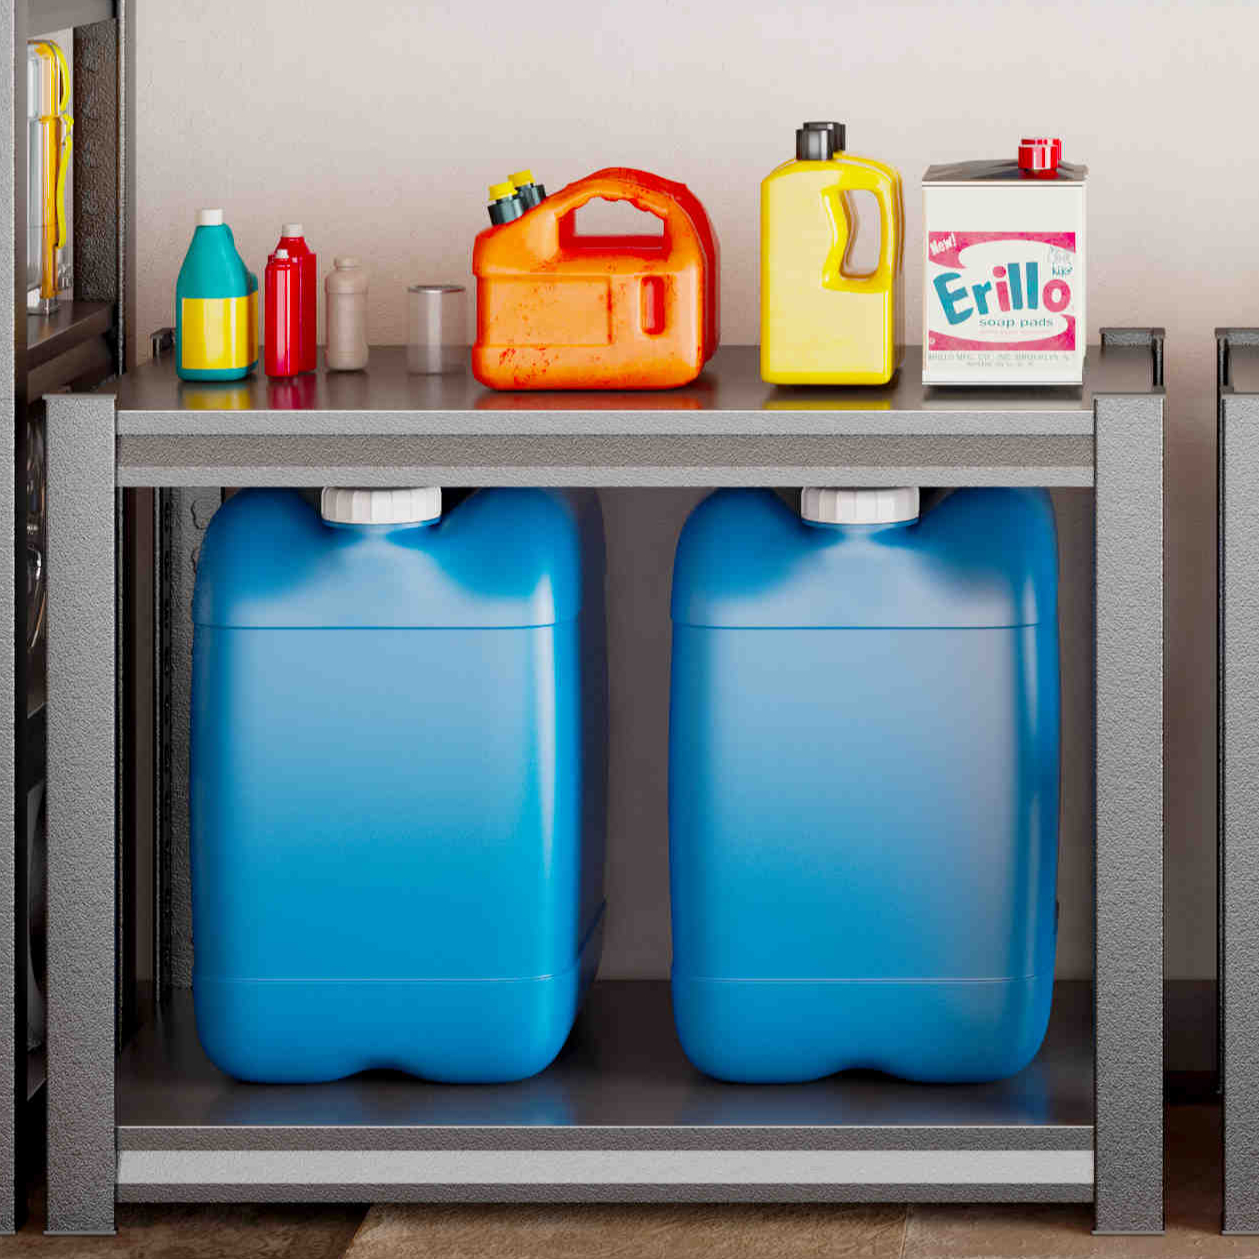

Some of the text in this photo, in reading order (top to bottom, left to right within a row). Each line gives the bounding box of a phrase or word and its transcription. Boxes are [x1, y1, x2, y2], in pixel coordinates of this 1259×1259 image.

[929, 232, 956, 256] New!
[933, 262, 1071, 325] Erillo
[979, 317, 1054, 329] soap pads
